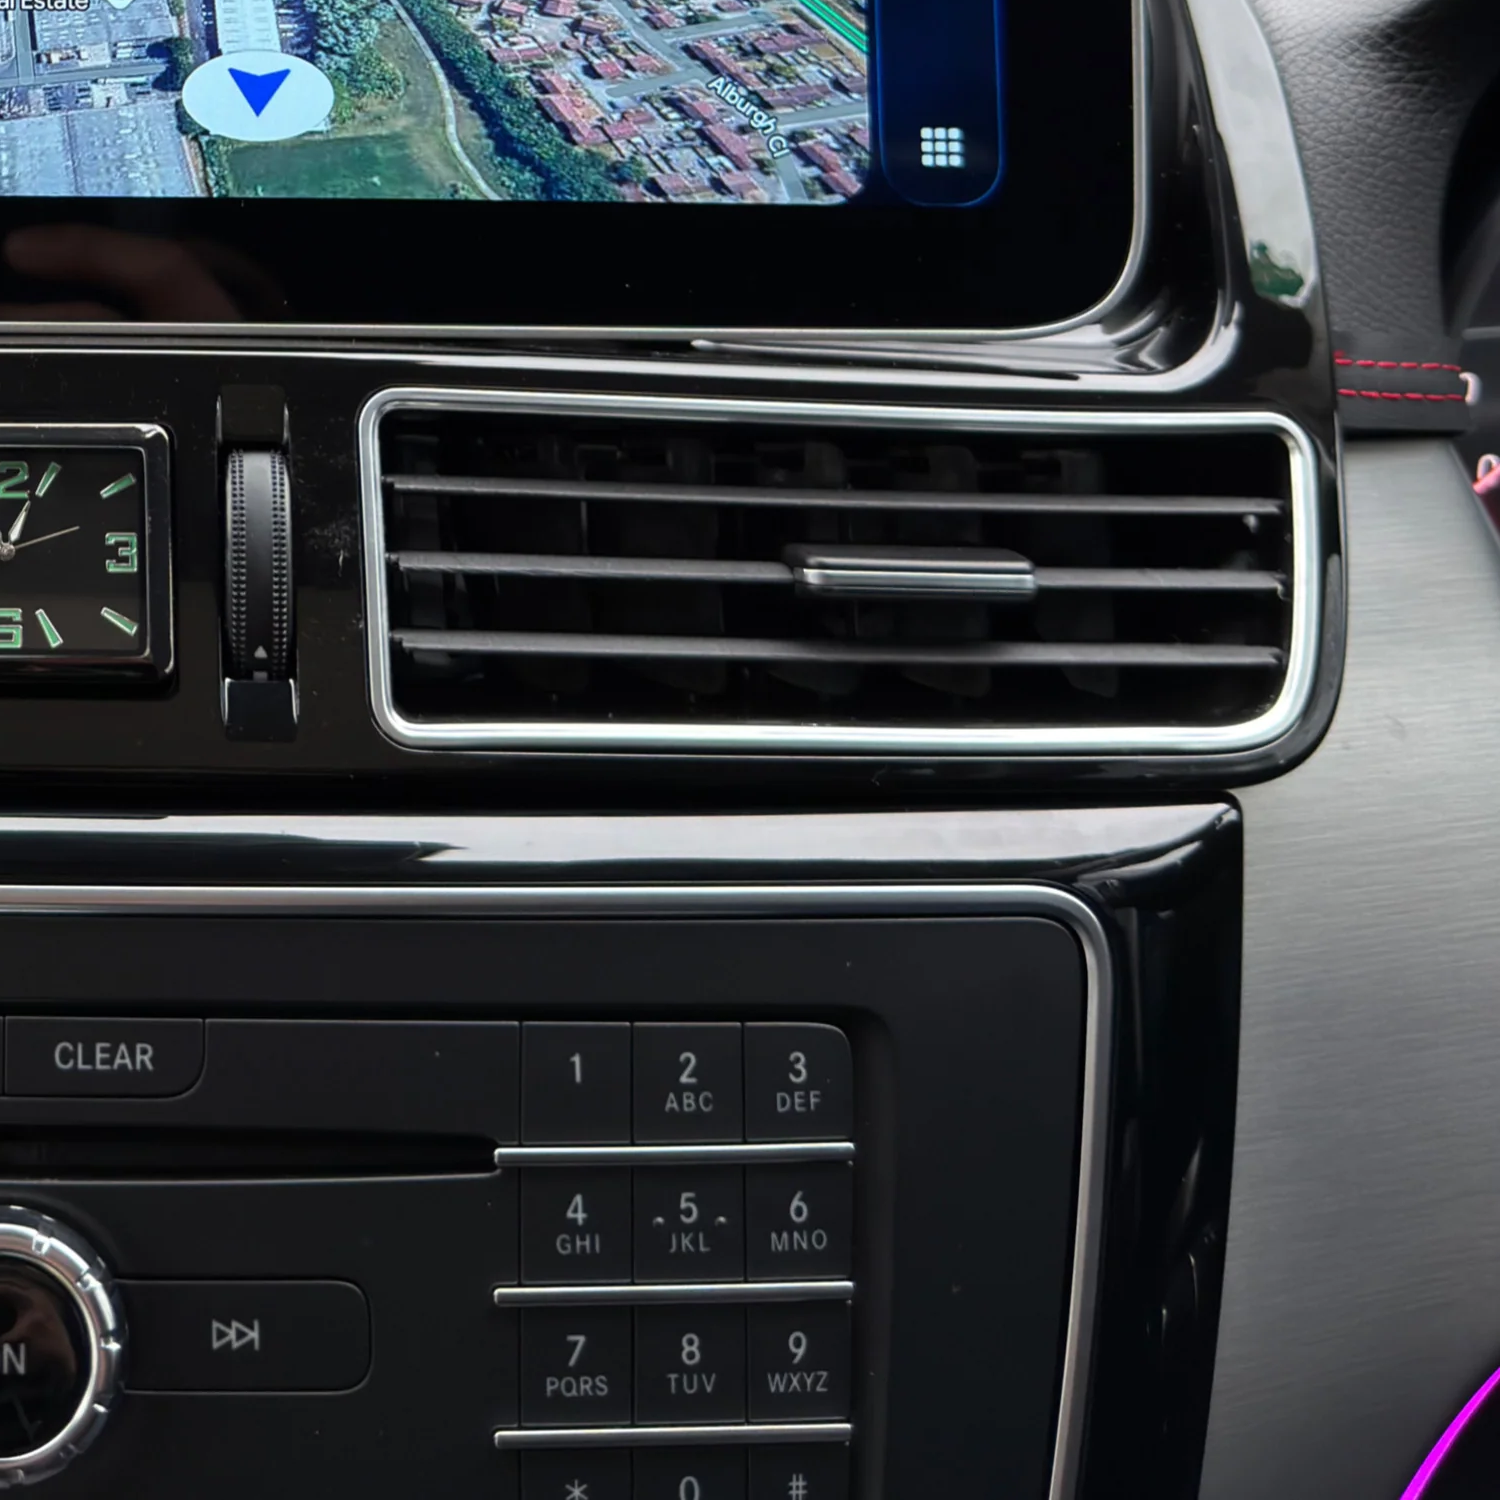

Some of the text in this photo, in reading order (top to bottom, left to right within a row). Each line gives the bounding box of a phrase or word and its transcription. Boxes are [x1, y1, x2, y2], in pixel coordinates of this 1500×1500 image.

[707, 76, 777, 135] Alburgh
[105, 532, 139, 573] 3
[54, 1041, 155, 1071] CLEAR
[569, 1052, 583, 1083] 1
[678, 1051, 698, 1084] 2
[788, 1051, 808, 1083] 3
[664, 1092, 714, 1113] ABC
[776, 1090, 822, 1113] DEF
[566, 1193, 588, 1226] 4
[679, 1192, 699, 1224] 5
[789, 1191, 809, 1223] 6
[555, 1233, 601, 1255] GHI
[668, 1232, 712, 1254] JKL
[770, 1229, 828, 1253] MNO
[566, 1334, 587, 1367] 7
[680, 1333, 701, 1366] 8
[787, 1331, 808, 1364] 9
[545, 1375, 609, 1398] PQRS
[667, 1372, 717, 1395] TUV
[767, 1371, 829, 1393] WXYZ
